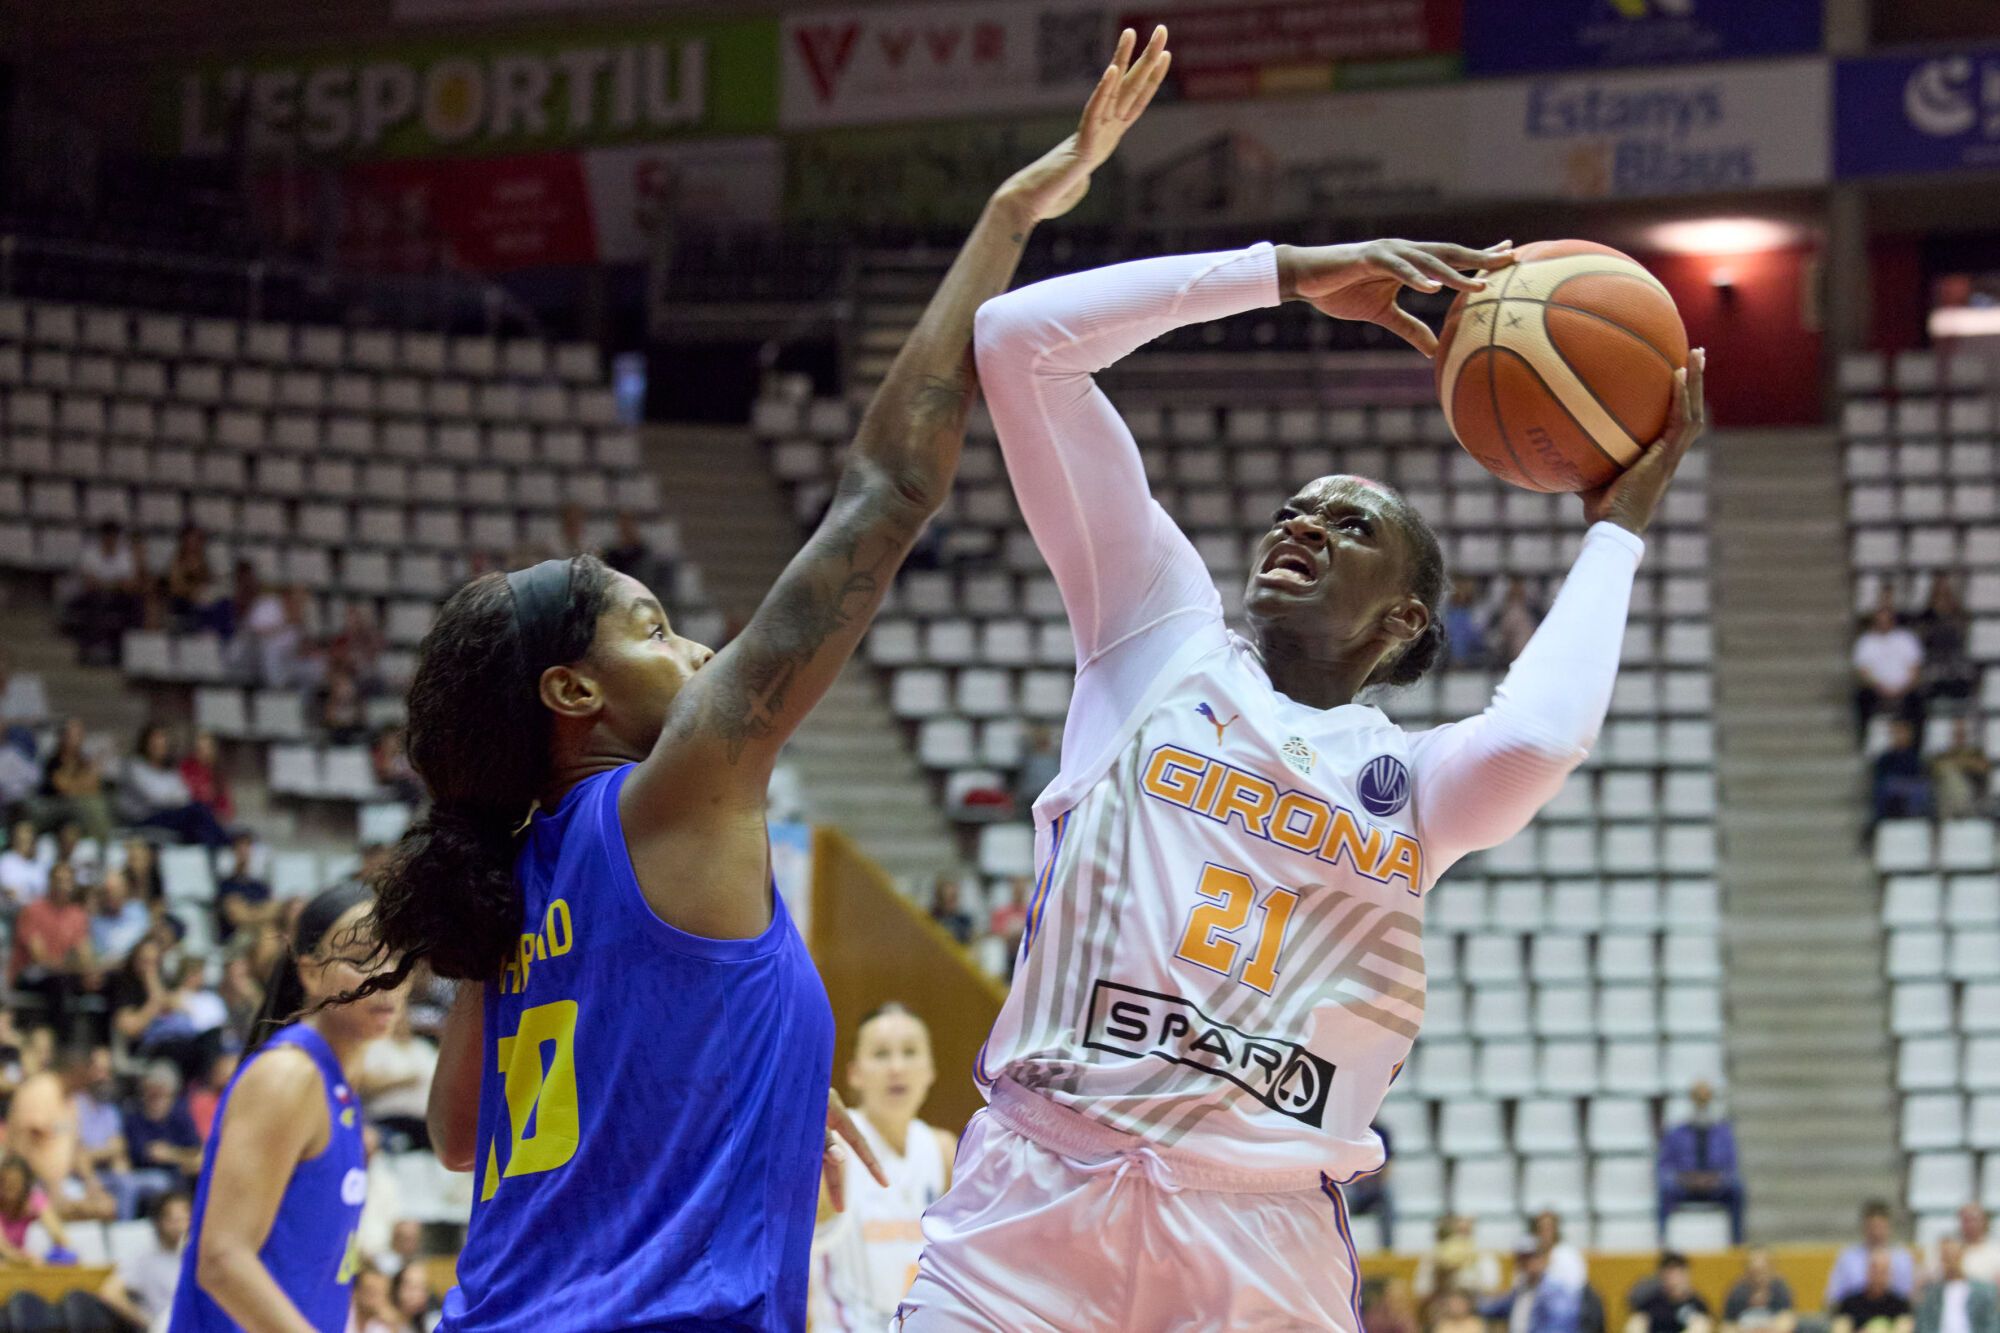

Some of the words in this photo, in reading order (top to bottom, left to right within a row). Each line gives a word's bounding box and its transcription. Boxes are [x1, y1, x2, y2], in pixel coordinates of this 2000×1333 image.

[179, 40, 708, 158] L'ESPORTIU
[1524, 78, 1724, 140] Estanys
[1140, 744, 1424, 898] GIRONA
[1174, 861, 1301, 998] 21
[1106, 1001, 1282, 1085] SPAR
